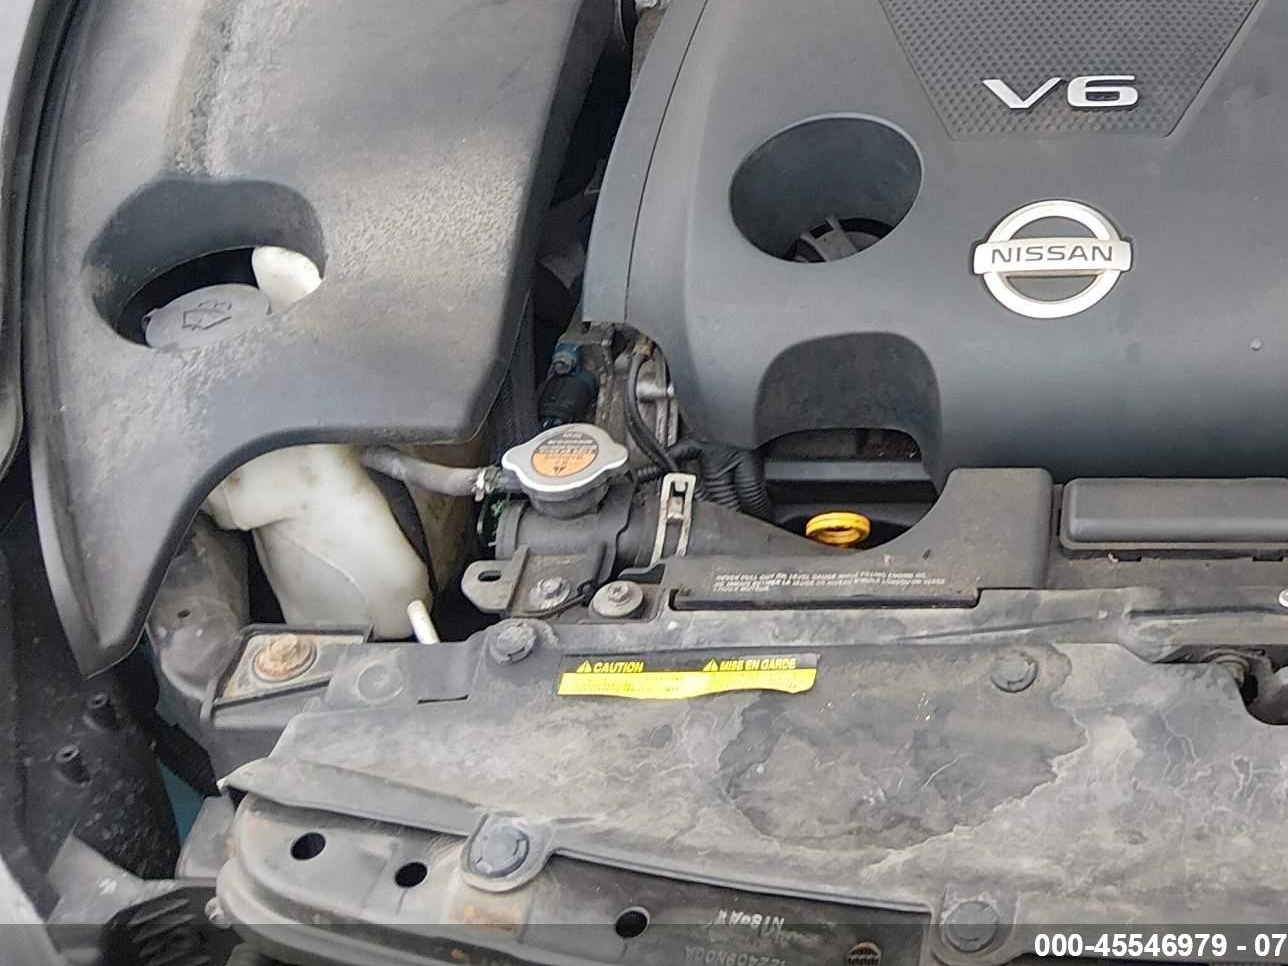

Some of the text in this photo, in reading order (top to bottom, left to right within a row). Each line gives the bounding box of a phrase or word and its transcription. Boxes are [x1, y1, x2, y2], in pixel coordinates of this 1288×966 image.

[982, 75, 1139, 109] V6
[991, 244, 1113, 265] NISSAN
[593, 661, 644, 673] CAUTION
[719, 657, 796, 672] MISE EN GARDE
